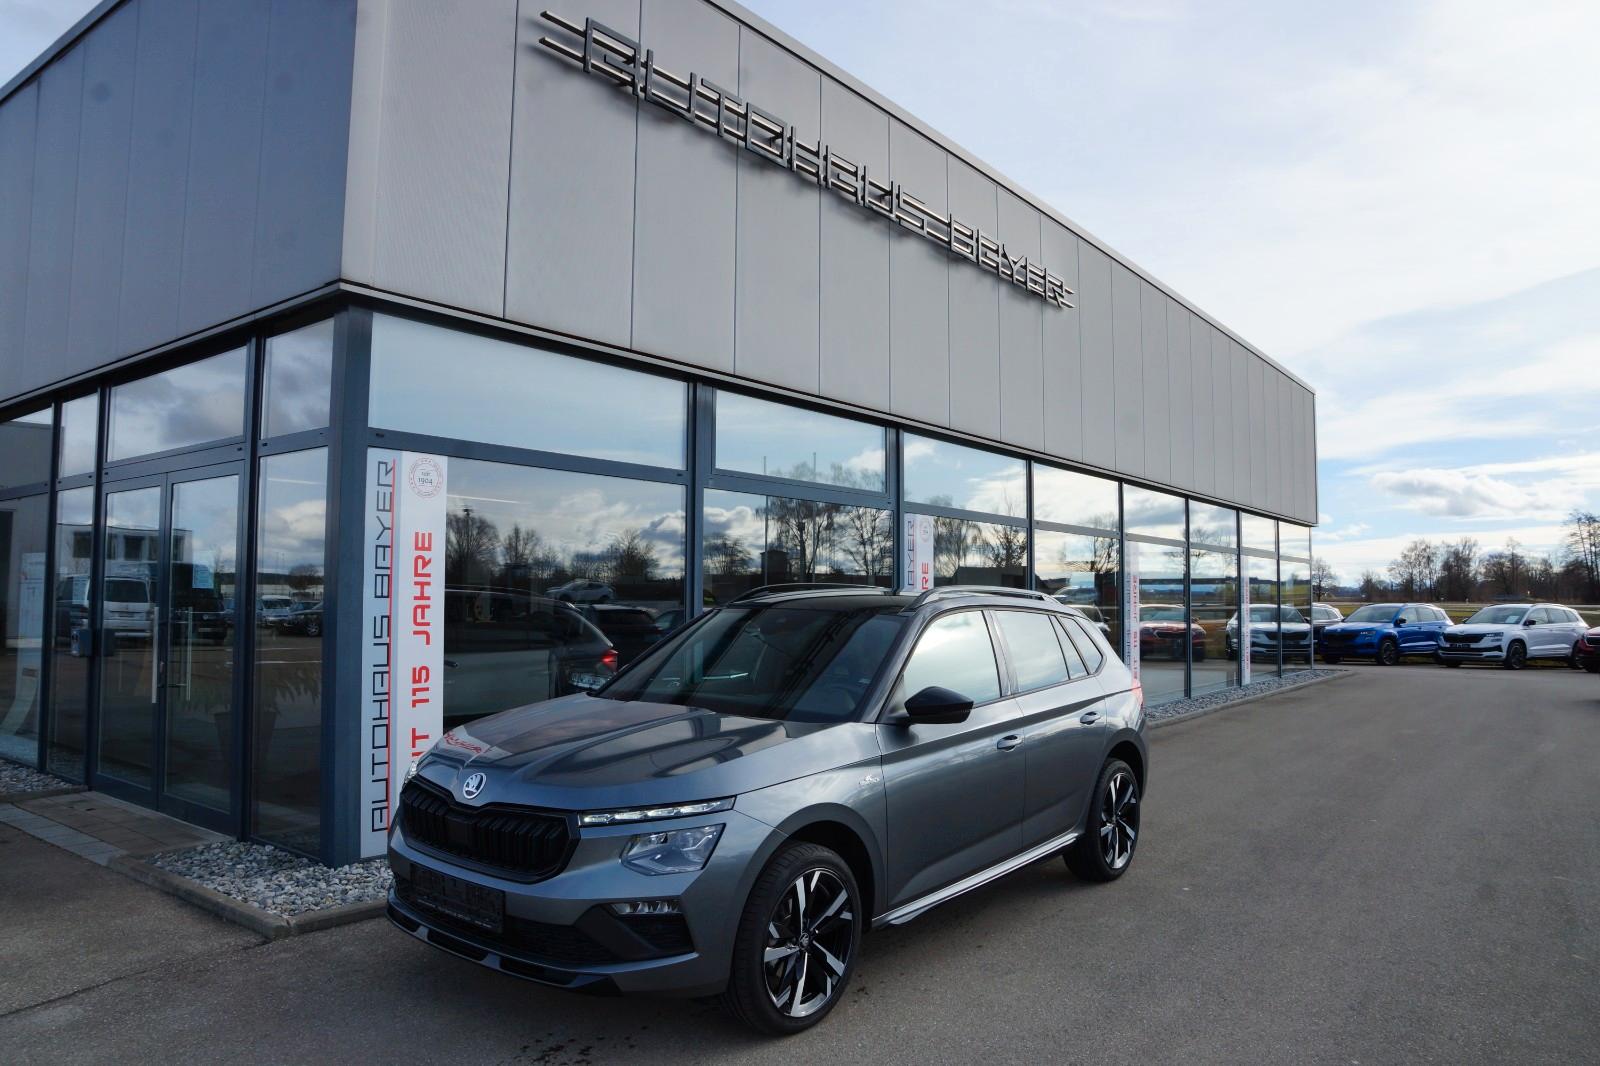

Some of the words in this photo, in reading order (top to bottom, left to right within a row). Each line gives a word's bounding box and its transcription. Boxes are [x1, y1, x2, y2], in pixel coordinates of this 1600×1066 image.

[583, 17, 927, 237] AUTOHAUS
[949, 213, 1064, 307] BAYER
[374, 461, 394, 599] BAYER
[418, 477, 433, 486] 1904
[413, 531, 433, 646] JAHRE
[372, 615, 389, 832] AUTOHAUS
[411, 665, 430, 709] 115
